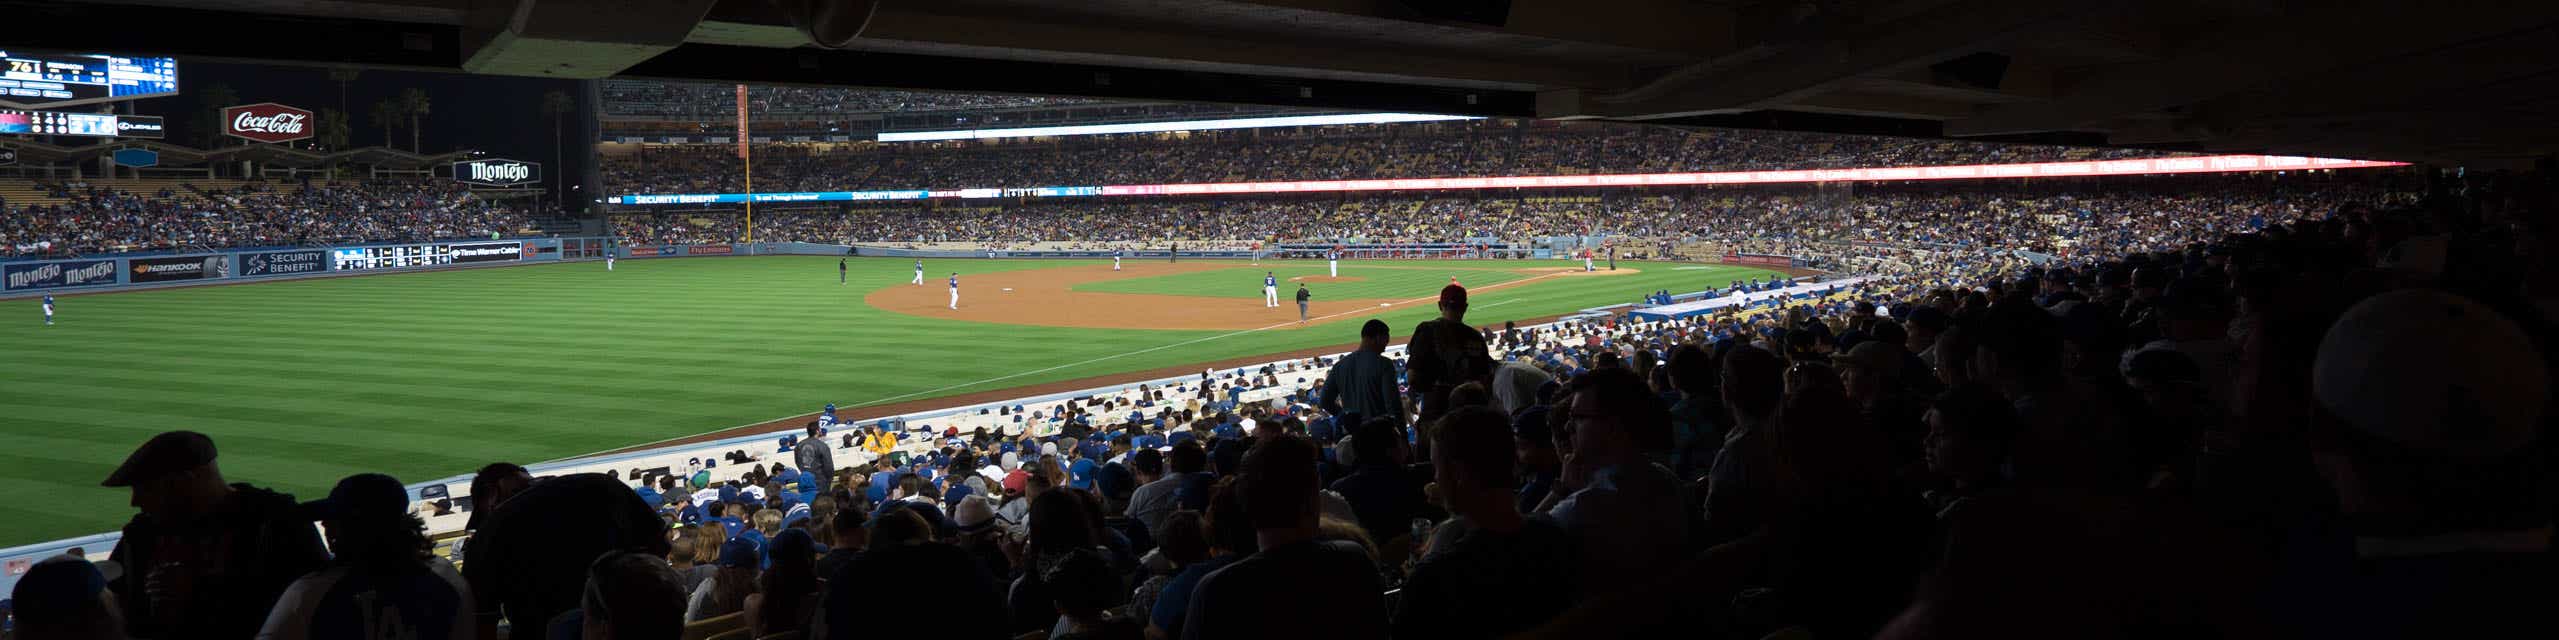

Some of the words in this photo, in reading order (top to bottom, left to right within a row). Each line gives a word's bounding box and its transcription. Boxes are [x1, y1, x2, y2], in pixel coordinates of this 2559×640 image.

[234, 111, 306, 134] Coca-Cola
[470, 161, 529, 182] Montejo
[270, 252, 321, 263] SECURITY
[270, 263, 314, 273] BENEFIT
[9, 264, 61, 288] Montejo
[65, 262, 114, 285] Montejo
